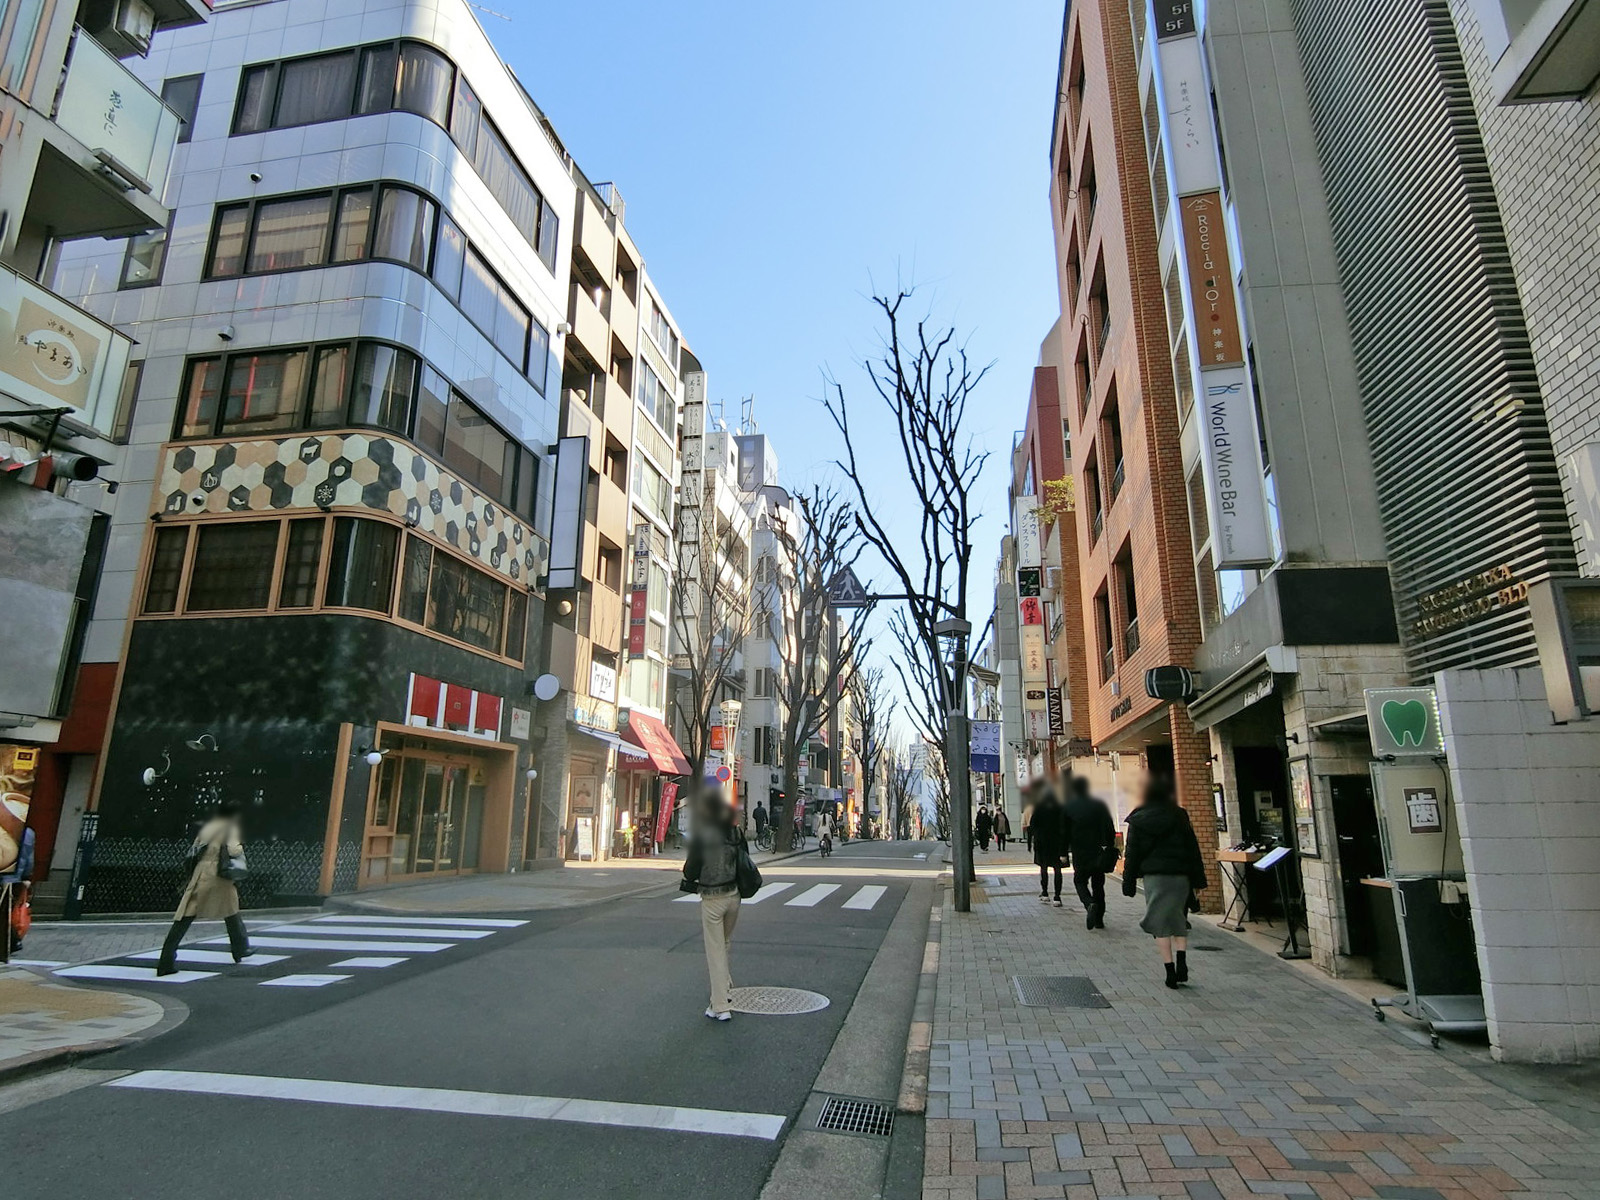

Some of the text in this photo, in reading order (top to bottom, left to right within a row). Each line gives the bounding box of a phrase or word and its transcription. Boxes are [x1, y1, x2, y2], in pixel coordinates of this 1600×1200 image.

[1165, 19, 1184, 31] 5F
[1171, 3, 1190, 15] 5F
[1197, 215, 1214, 270] Roccia
[1220, 490, 1237, 517] Bar
[1021, 513, 1031, 564] ダンススクール
[1049, 689, 1061, 730] KANAN
[1407, 793, 1439, 827] 歯
